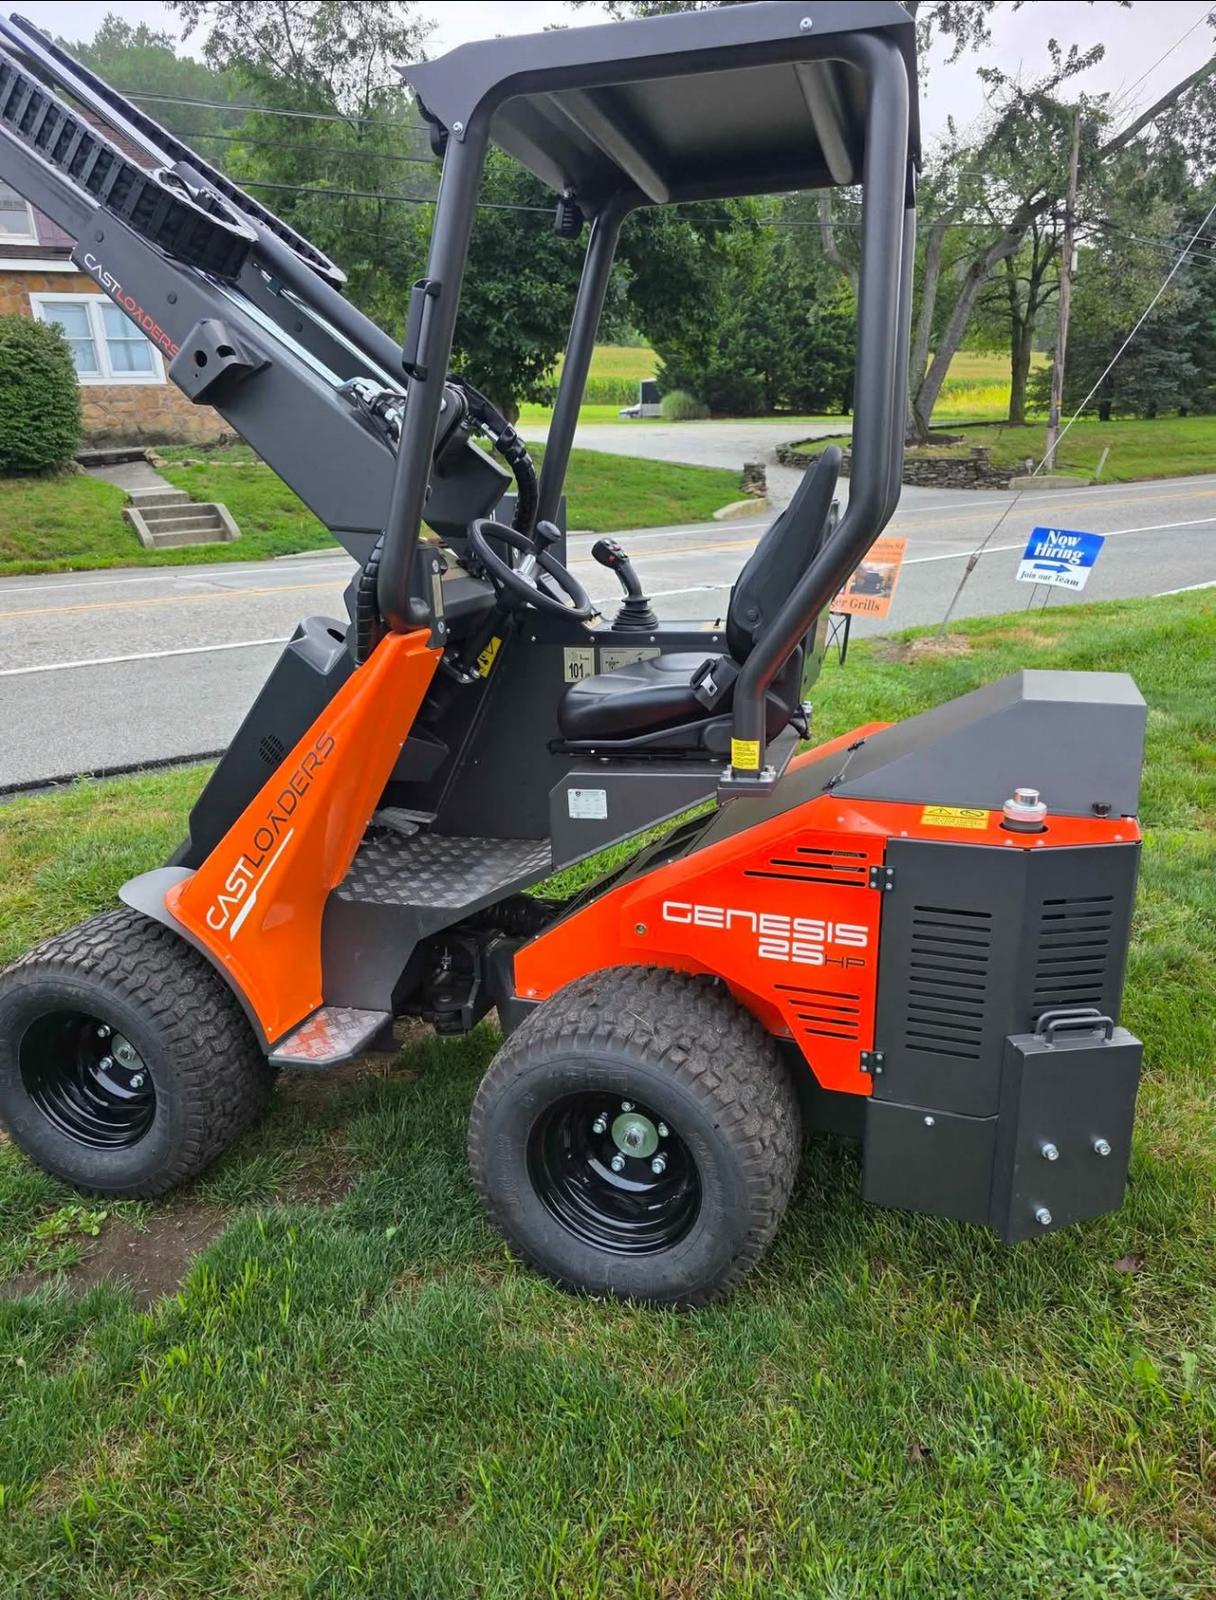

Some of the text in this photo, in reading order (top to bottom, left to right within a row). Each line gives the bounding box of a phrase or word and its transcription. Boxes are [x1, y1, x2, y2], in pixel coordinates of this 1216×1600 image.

[1046, 530, 1082, 547] Now
[1033, 542, 1084, 565] Hiring
[1019, 570, 1037, 580] Join
[1054, 574, 1080, 586] Team
[849, 598, 880, 612] Grills
[568, 662, 584, 679] 101
[206, 730, 336, 931] CASTLOADERS
[662, 900, 869, 948] GENESIS
